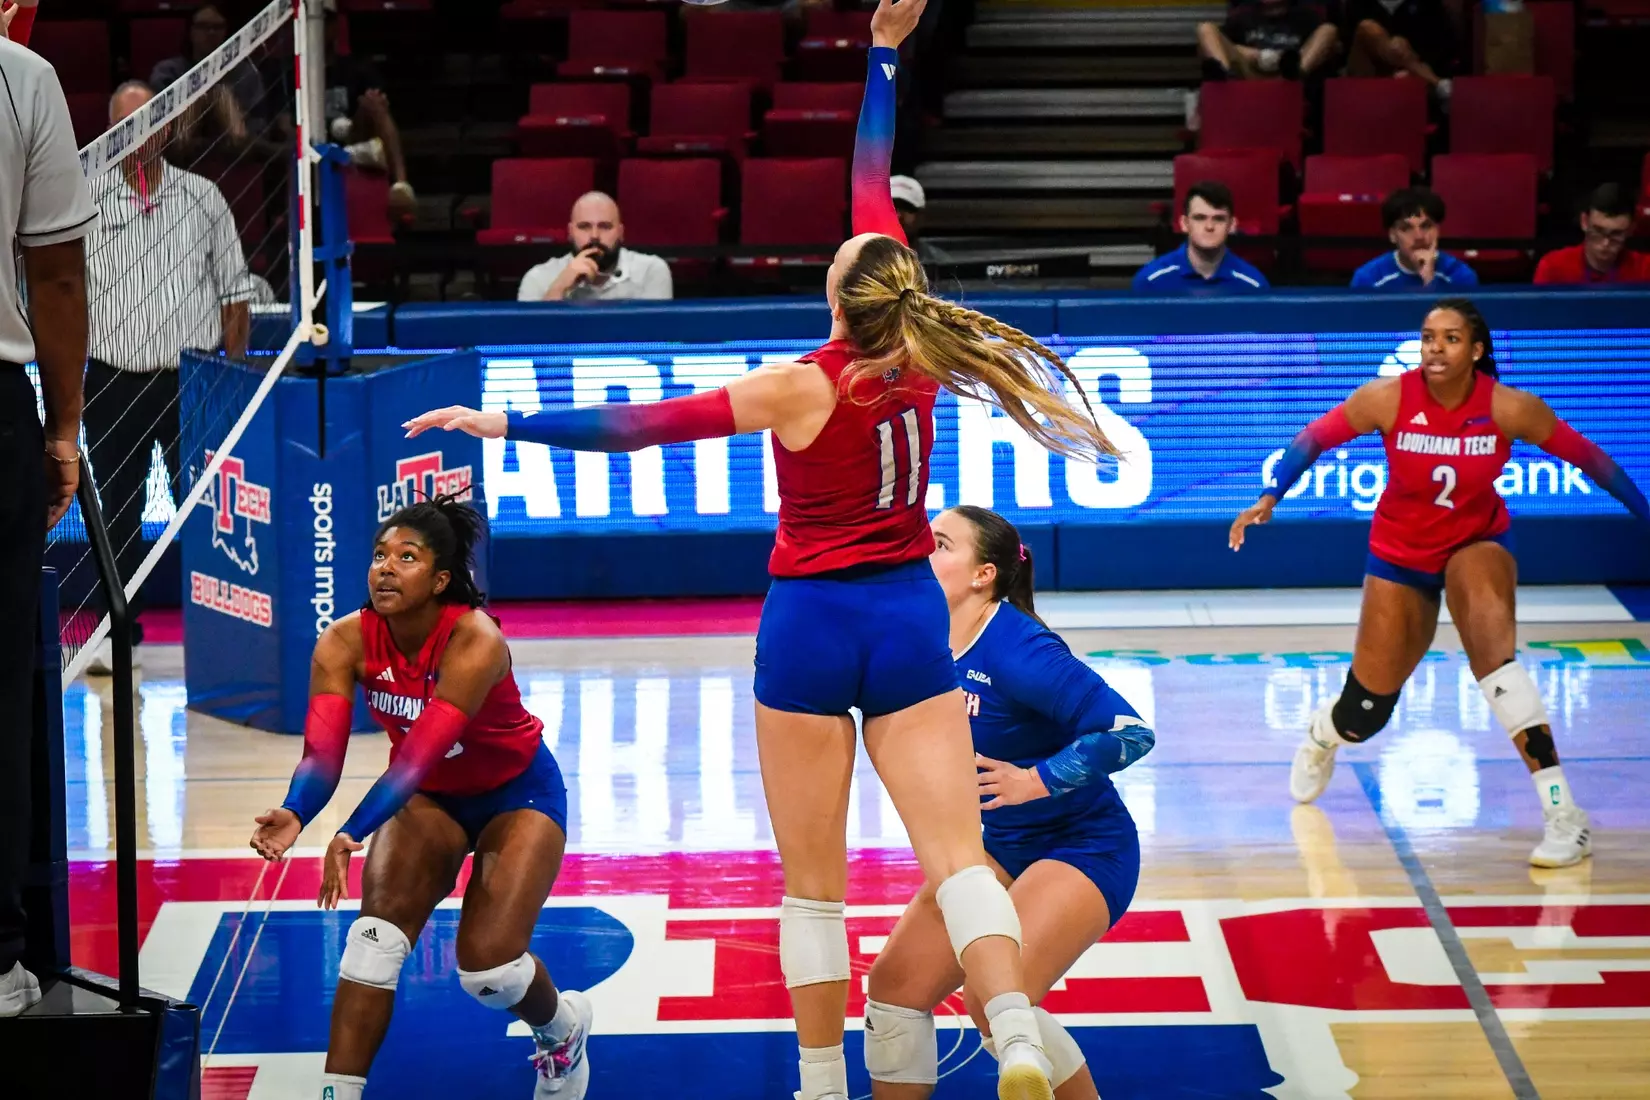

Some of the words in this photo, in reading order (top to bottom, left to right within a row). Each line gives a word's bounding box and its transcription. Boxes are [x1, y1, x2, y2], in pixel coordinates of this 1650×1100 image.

[482, 347, 1152, 518] ARTRS
[875, 407, 922, 509] 11
[1396, 431, 1460, 456] LOUISIANA
[1464, 435, 1497, 456] TECH
[1261, 448, 1385, 511] Orig
[1493, 462, 1591, 495] ank
[1432, 464, 1457, 509] 2
[308, 483, 336, 563] sports
[191, 570, 272, 628] BULLDOGS
[310, 566, 335, 640] impo
[368, 689, 425, 721] OUISIAN
